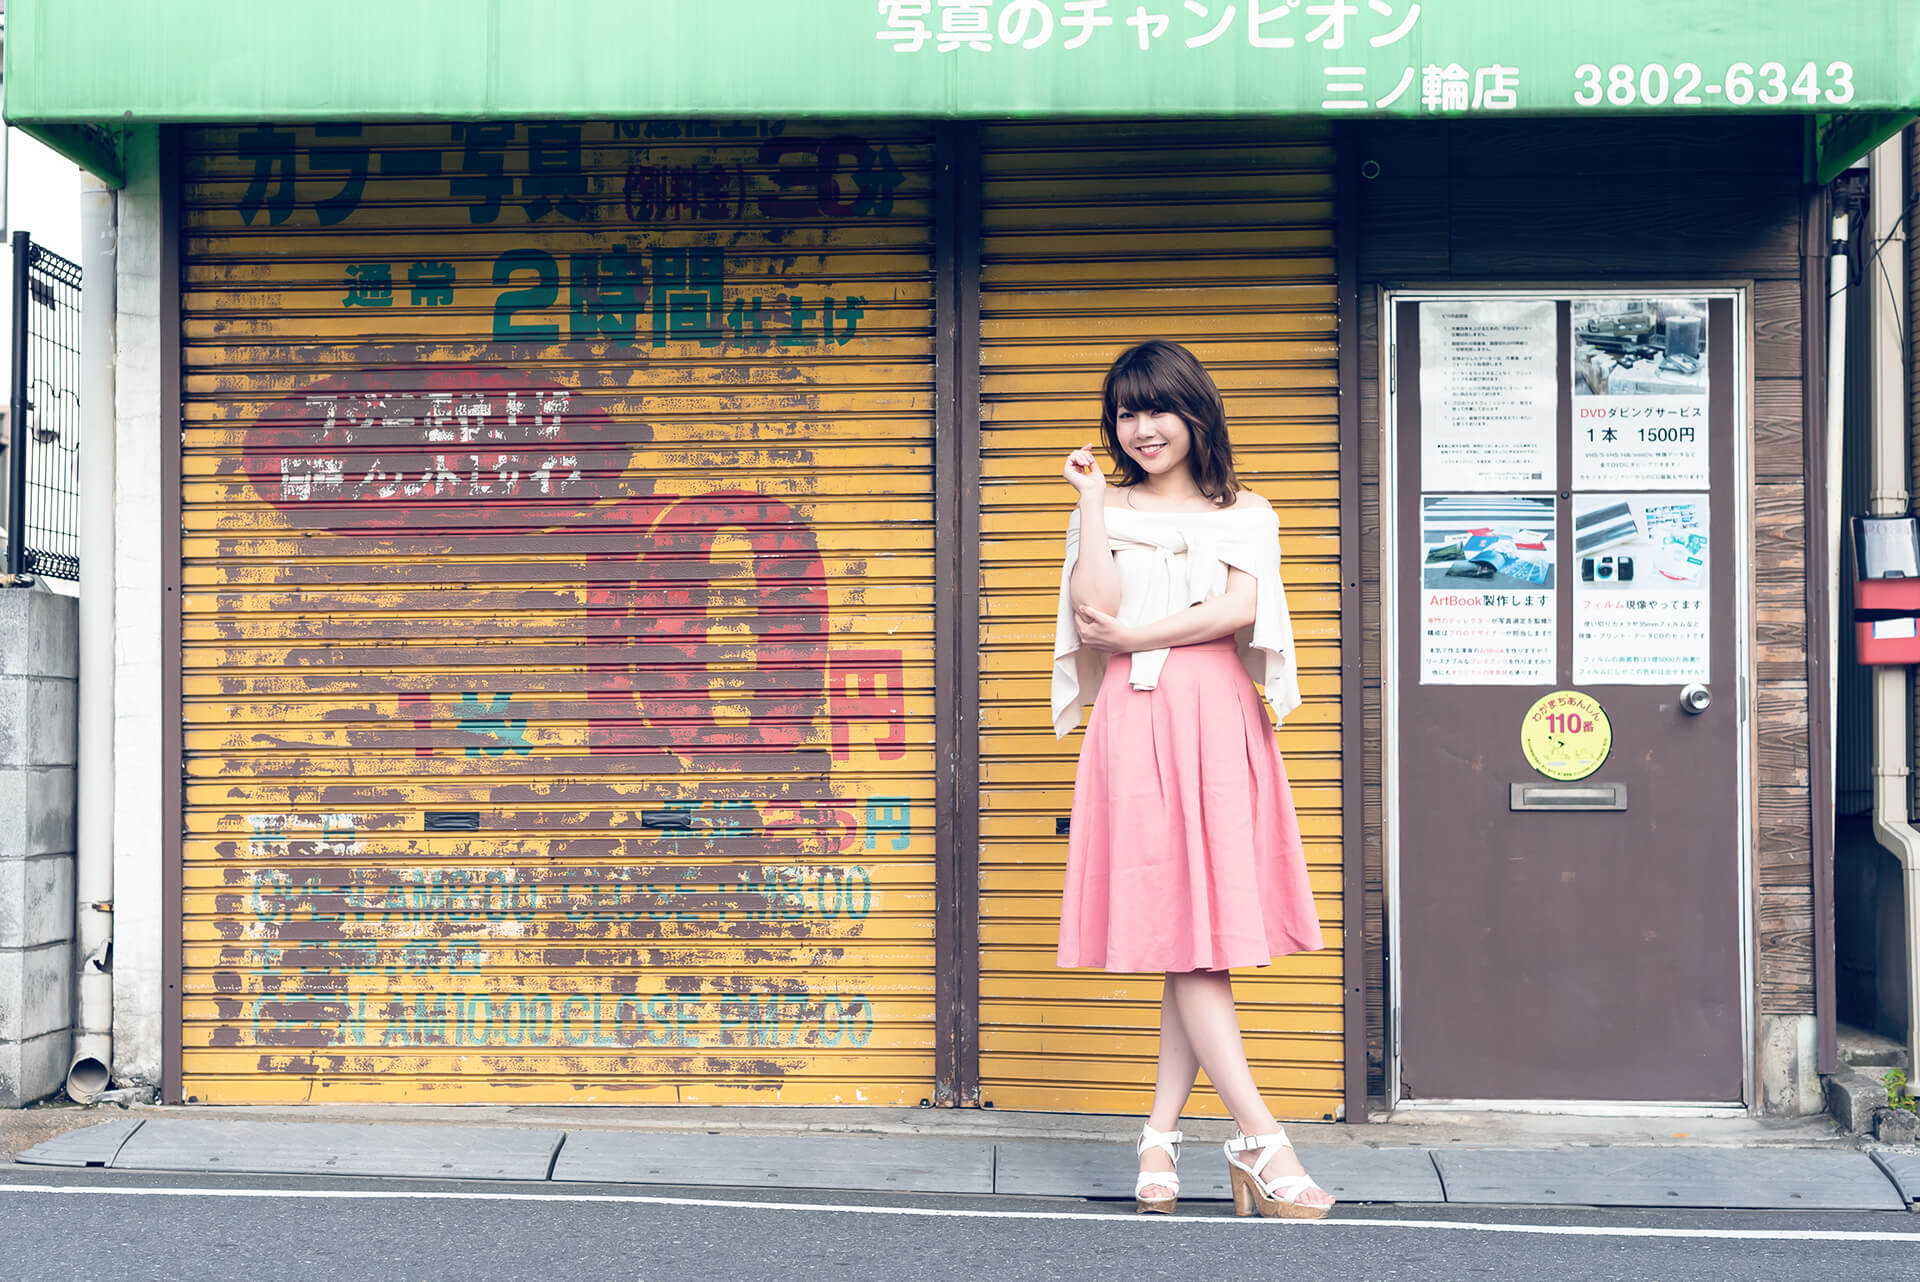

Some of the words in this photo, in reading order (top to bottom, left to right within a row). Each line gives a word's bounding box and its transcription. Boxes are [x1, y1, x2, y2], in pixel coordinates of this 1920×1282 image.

[876, 0, 1421, 52] 写真のチャンピオン
[1322, 65, 1520, 111] 三ノ輪店
[1574, 62, 1855, 105] 3802-6343
[1580, 408, 1702, 418] DVDダビングサービス
[1586, 427, 1618, 443] 1本
[1638, 427, 1695, 443] 1500円
[1430, 595, 1548, 607] ArtBook製作します
[1583, 600, 1702, 610] フィルム現像やってます
[1545, 712, 1594, 733] 110番
